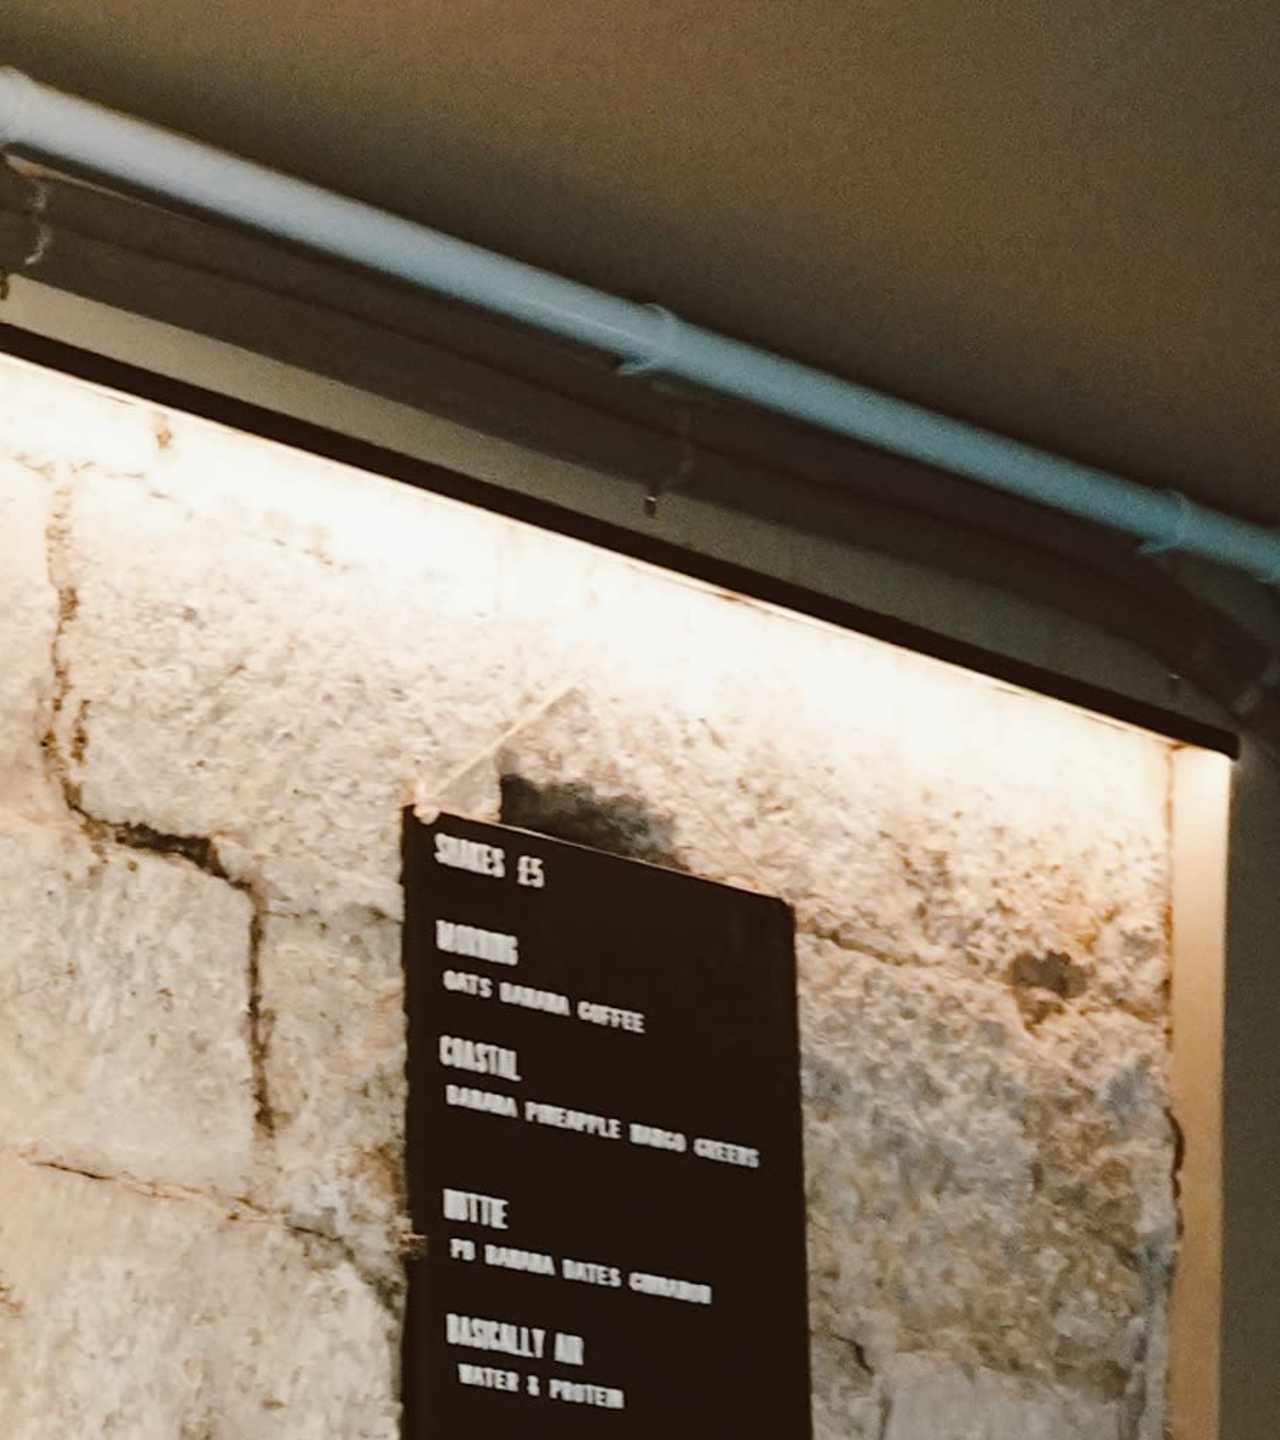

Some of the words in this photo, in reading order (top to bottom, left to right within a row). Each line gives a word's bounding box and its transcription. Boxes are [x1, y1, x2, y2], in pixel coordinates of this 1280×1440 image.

[443, 970, 492, 998] OATS
[499, 982, 570, 1016] BANANA
[577, 1001, 645, 1033] COFFEE
[446, 1084, 518, 1118] BANANA
[524, 1101, 621, 1139] PINEAPPLE
[450, 1238, 475, 1261] PB
[484, 1244, 555, 1276] BANANA
[562, 1259, 621, 1287] DATES
[446, 1313, 545, 1358] BASICALLY
[458, 1363, 519, 1392] WATER
[549, 1379, 624, 1409] PROTEIN
